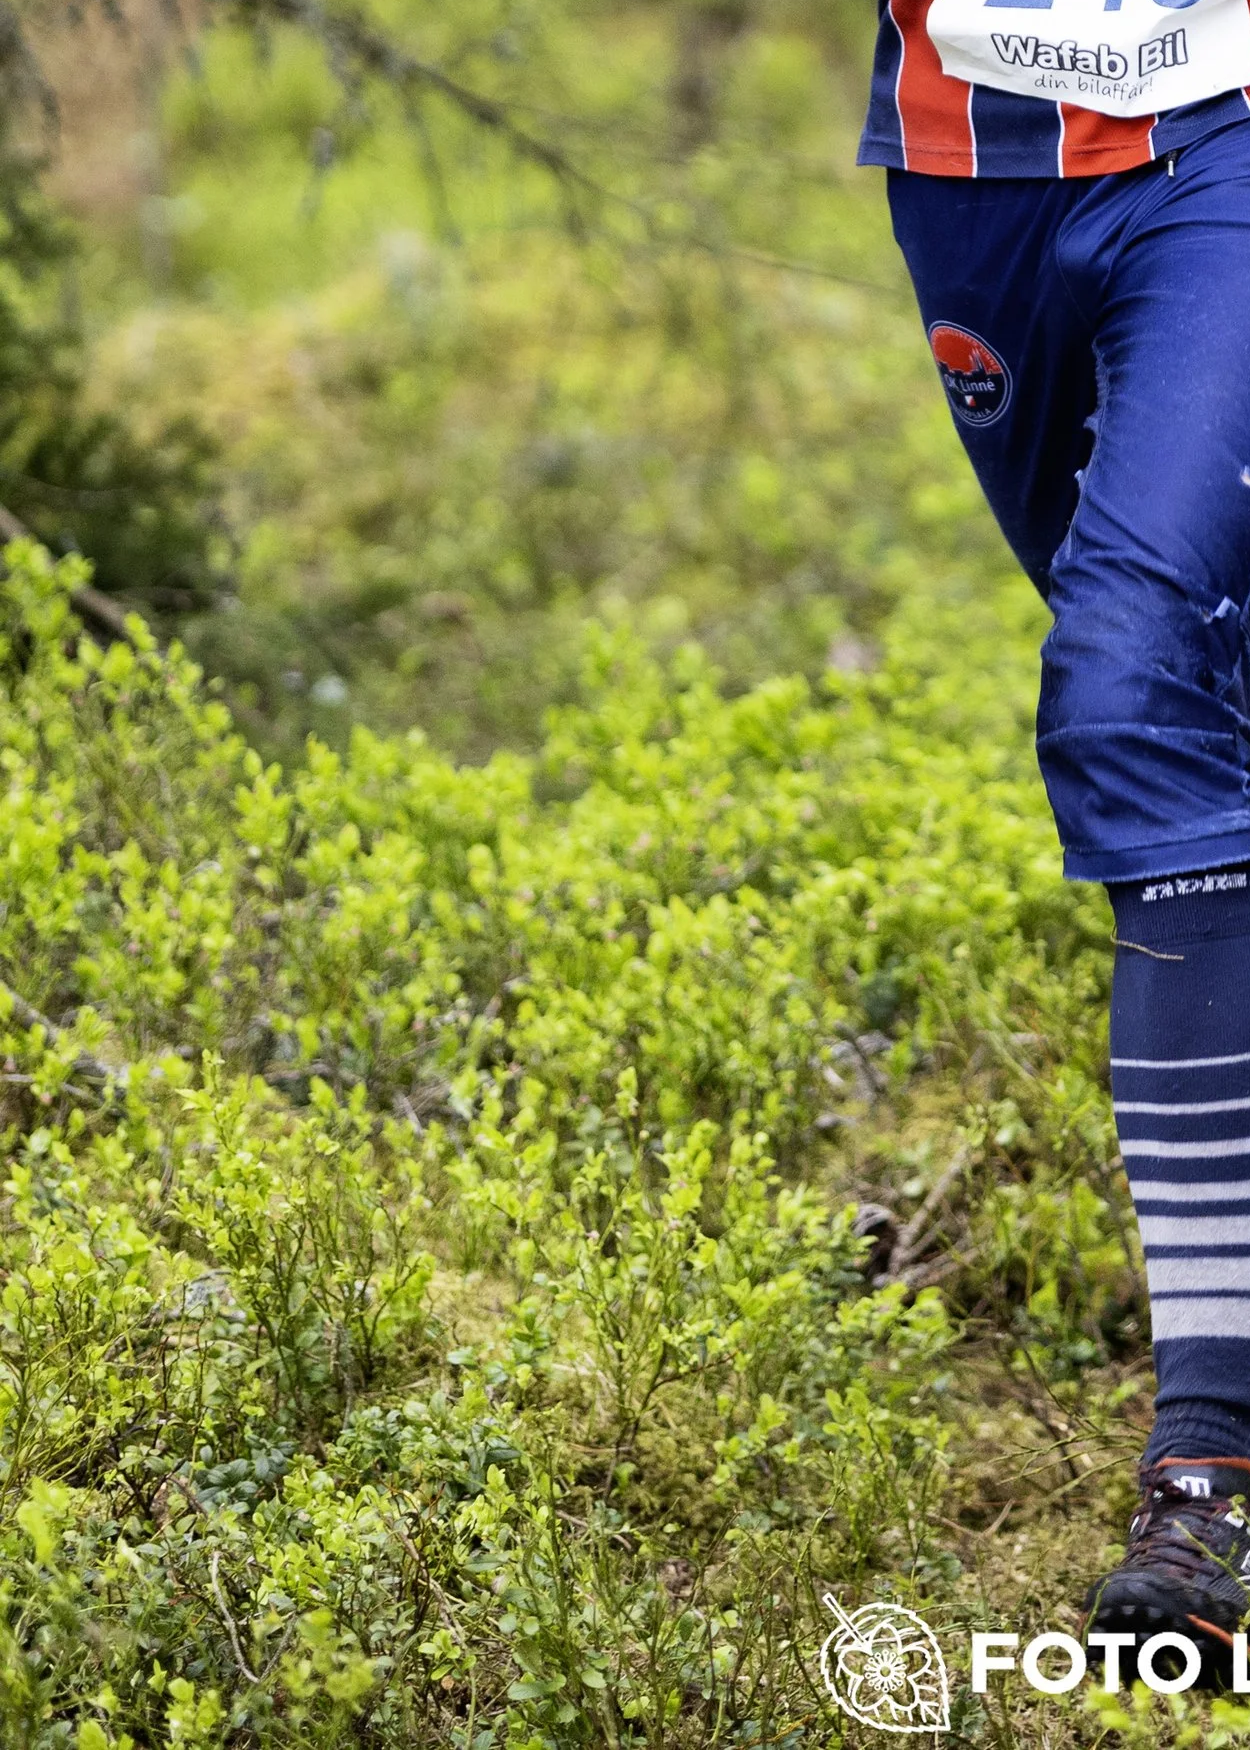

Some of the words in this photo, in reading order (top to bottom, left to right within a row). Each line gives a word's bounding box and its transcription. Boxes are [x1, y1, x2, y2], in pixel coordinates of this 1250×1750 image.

[992, 32, 1128, 81] Wafab
[1137, 28, 1190, 78] Bil
[1034, 73, 1069, 90] din
[959, 377, 997, 393] Linné
